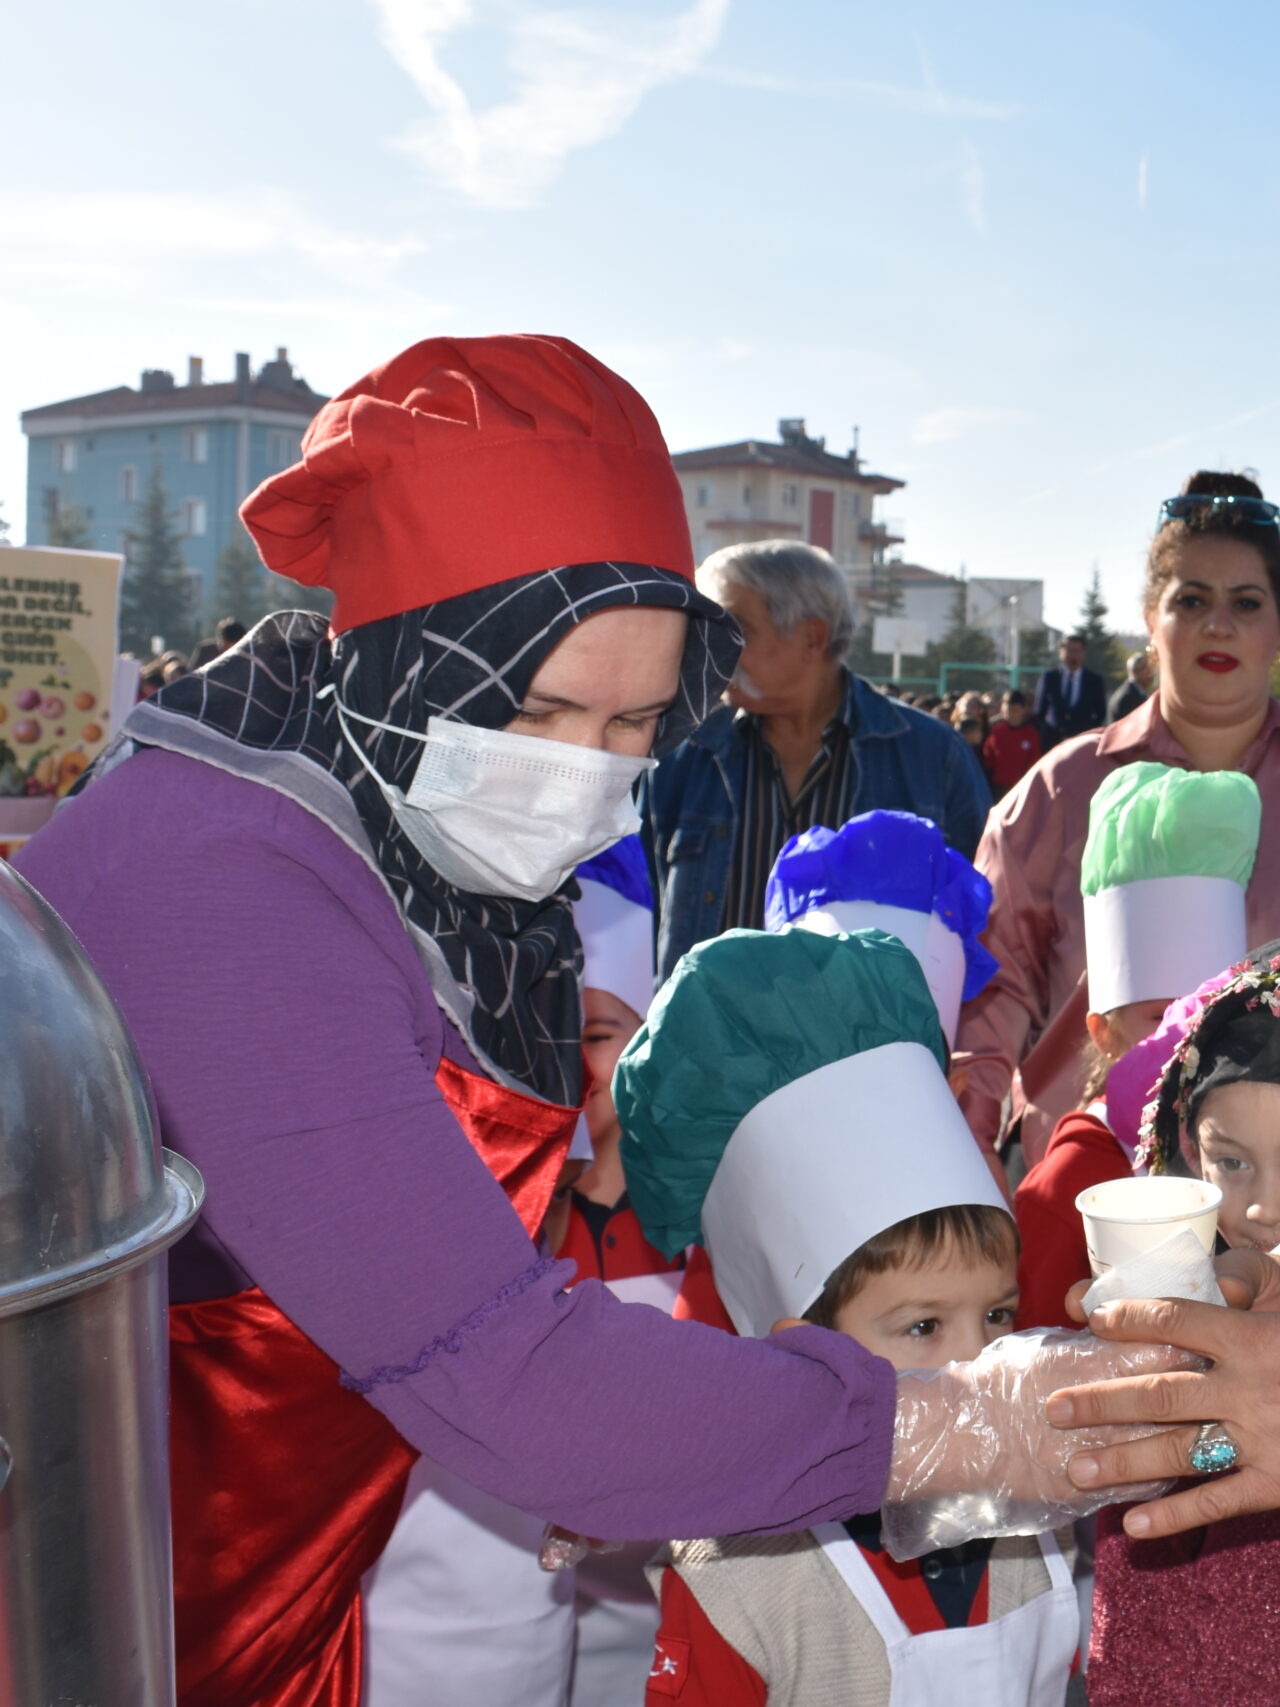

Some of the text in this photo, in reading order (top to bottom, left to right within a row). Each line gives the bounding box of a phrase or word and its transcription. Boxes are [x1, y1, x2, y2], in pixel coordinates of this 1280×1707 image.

[0, 577, 81, 598] LENMİŞ
[0, 613, 72, 632] ERÇEK
[2, 631, 55, 647] GIDA
[0, 647, 66, 666] ÜKET.
